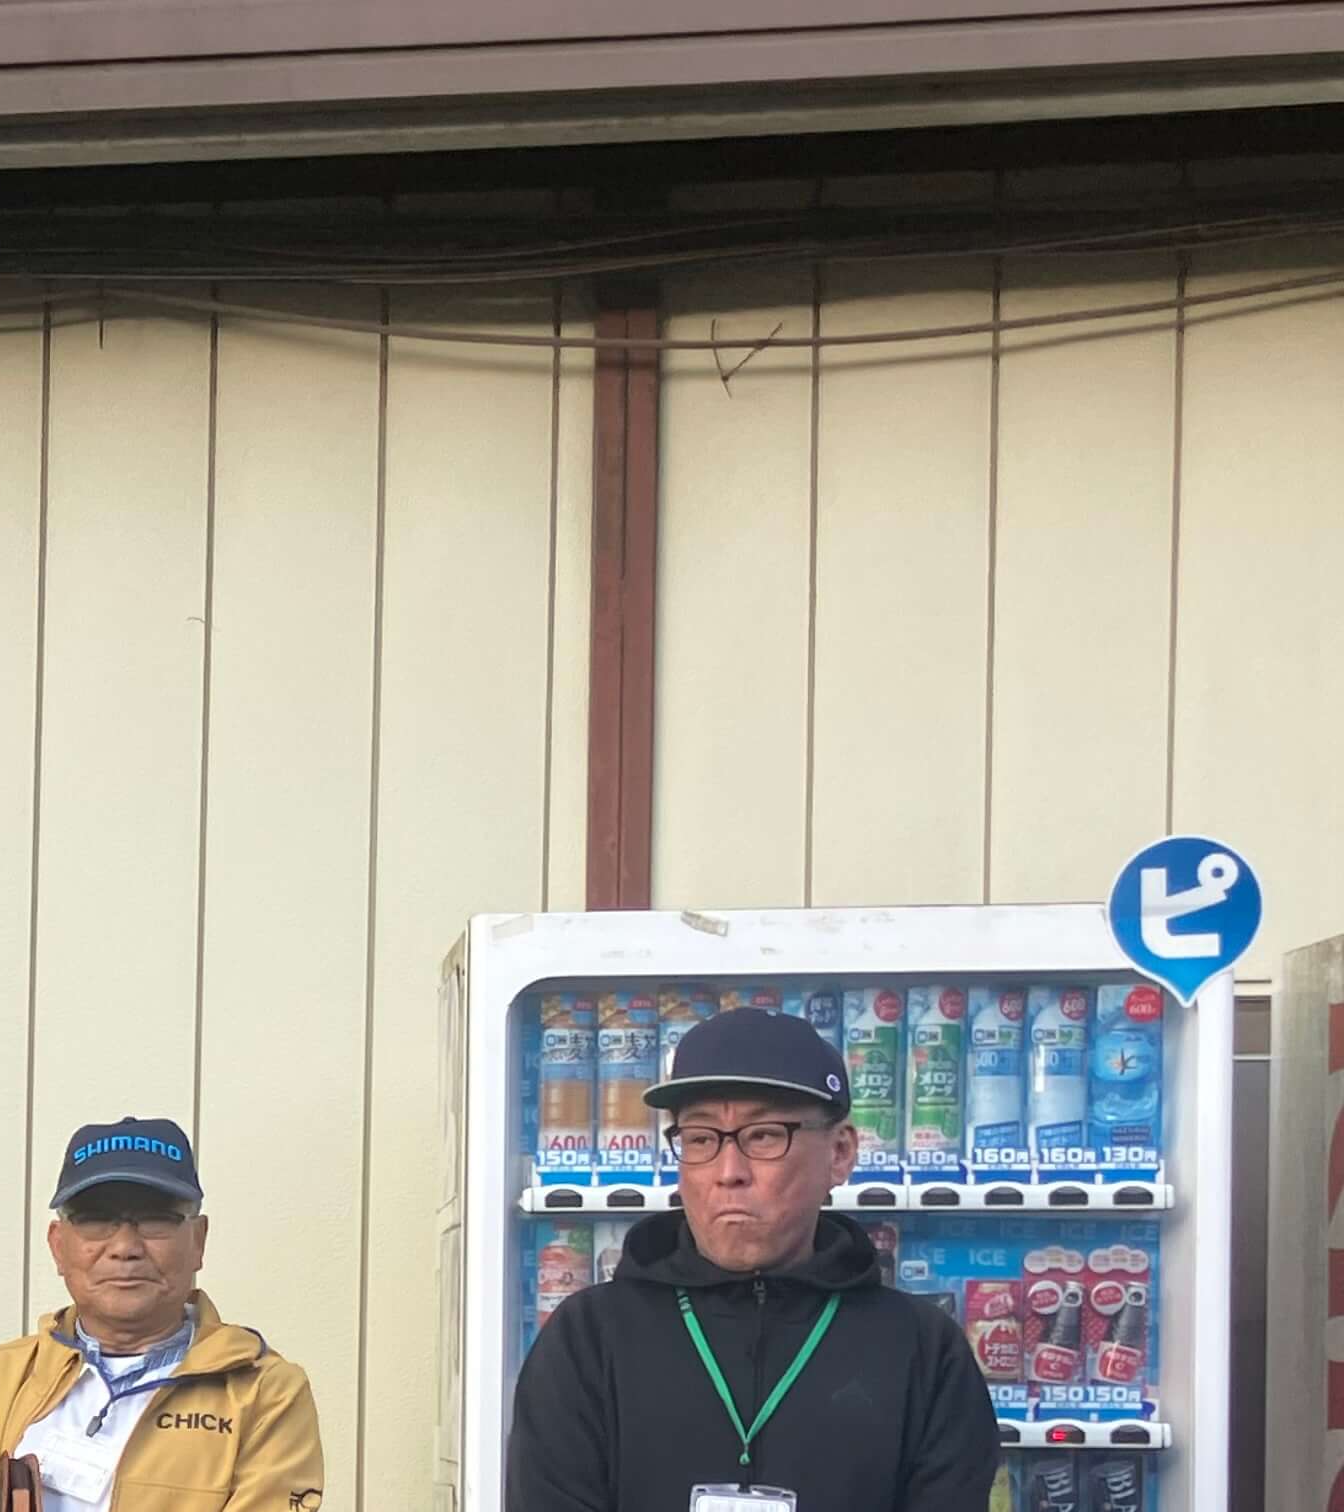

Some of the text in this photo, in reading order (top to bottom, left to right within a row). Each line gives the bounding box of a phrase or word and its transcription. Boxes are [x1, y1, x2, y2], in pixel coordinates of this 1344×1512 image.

[1140, 853, 1239, 960] ピ
[73, 1135, 183, 1166] SHIMANO
[539, 1150, 589, 1167] 150円
[600, 1150, 652, 1167] 150円
[858, 1151, 899, 1165] 80円
[908, 1151, 956, 1166] 180円
[974, 1148, 1029, 1164] 160円
[1041, 1148, 1096, 1164] 160円
[1102, 1147, 1157, 1163] 130円
[969, 1249, 1007, 1266] ICE
[156, 1412, 233, 1434] CHICK
